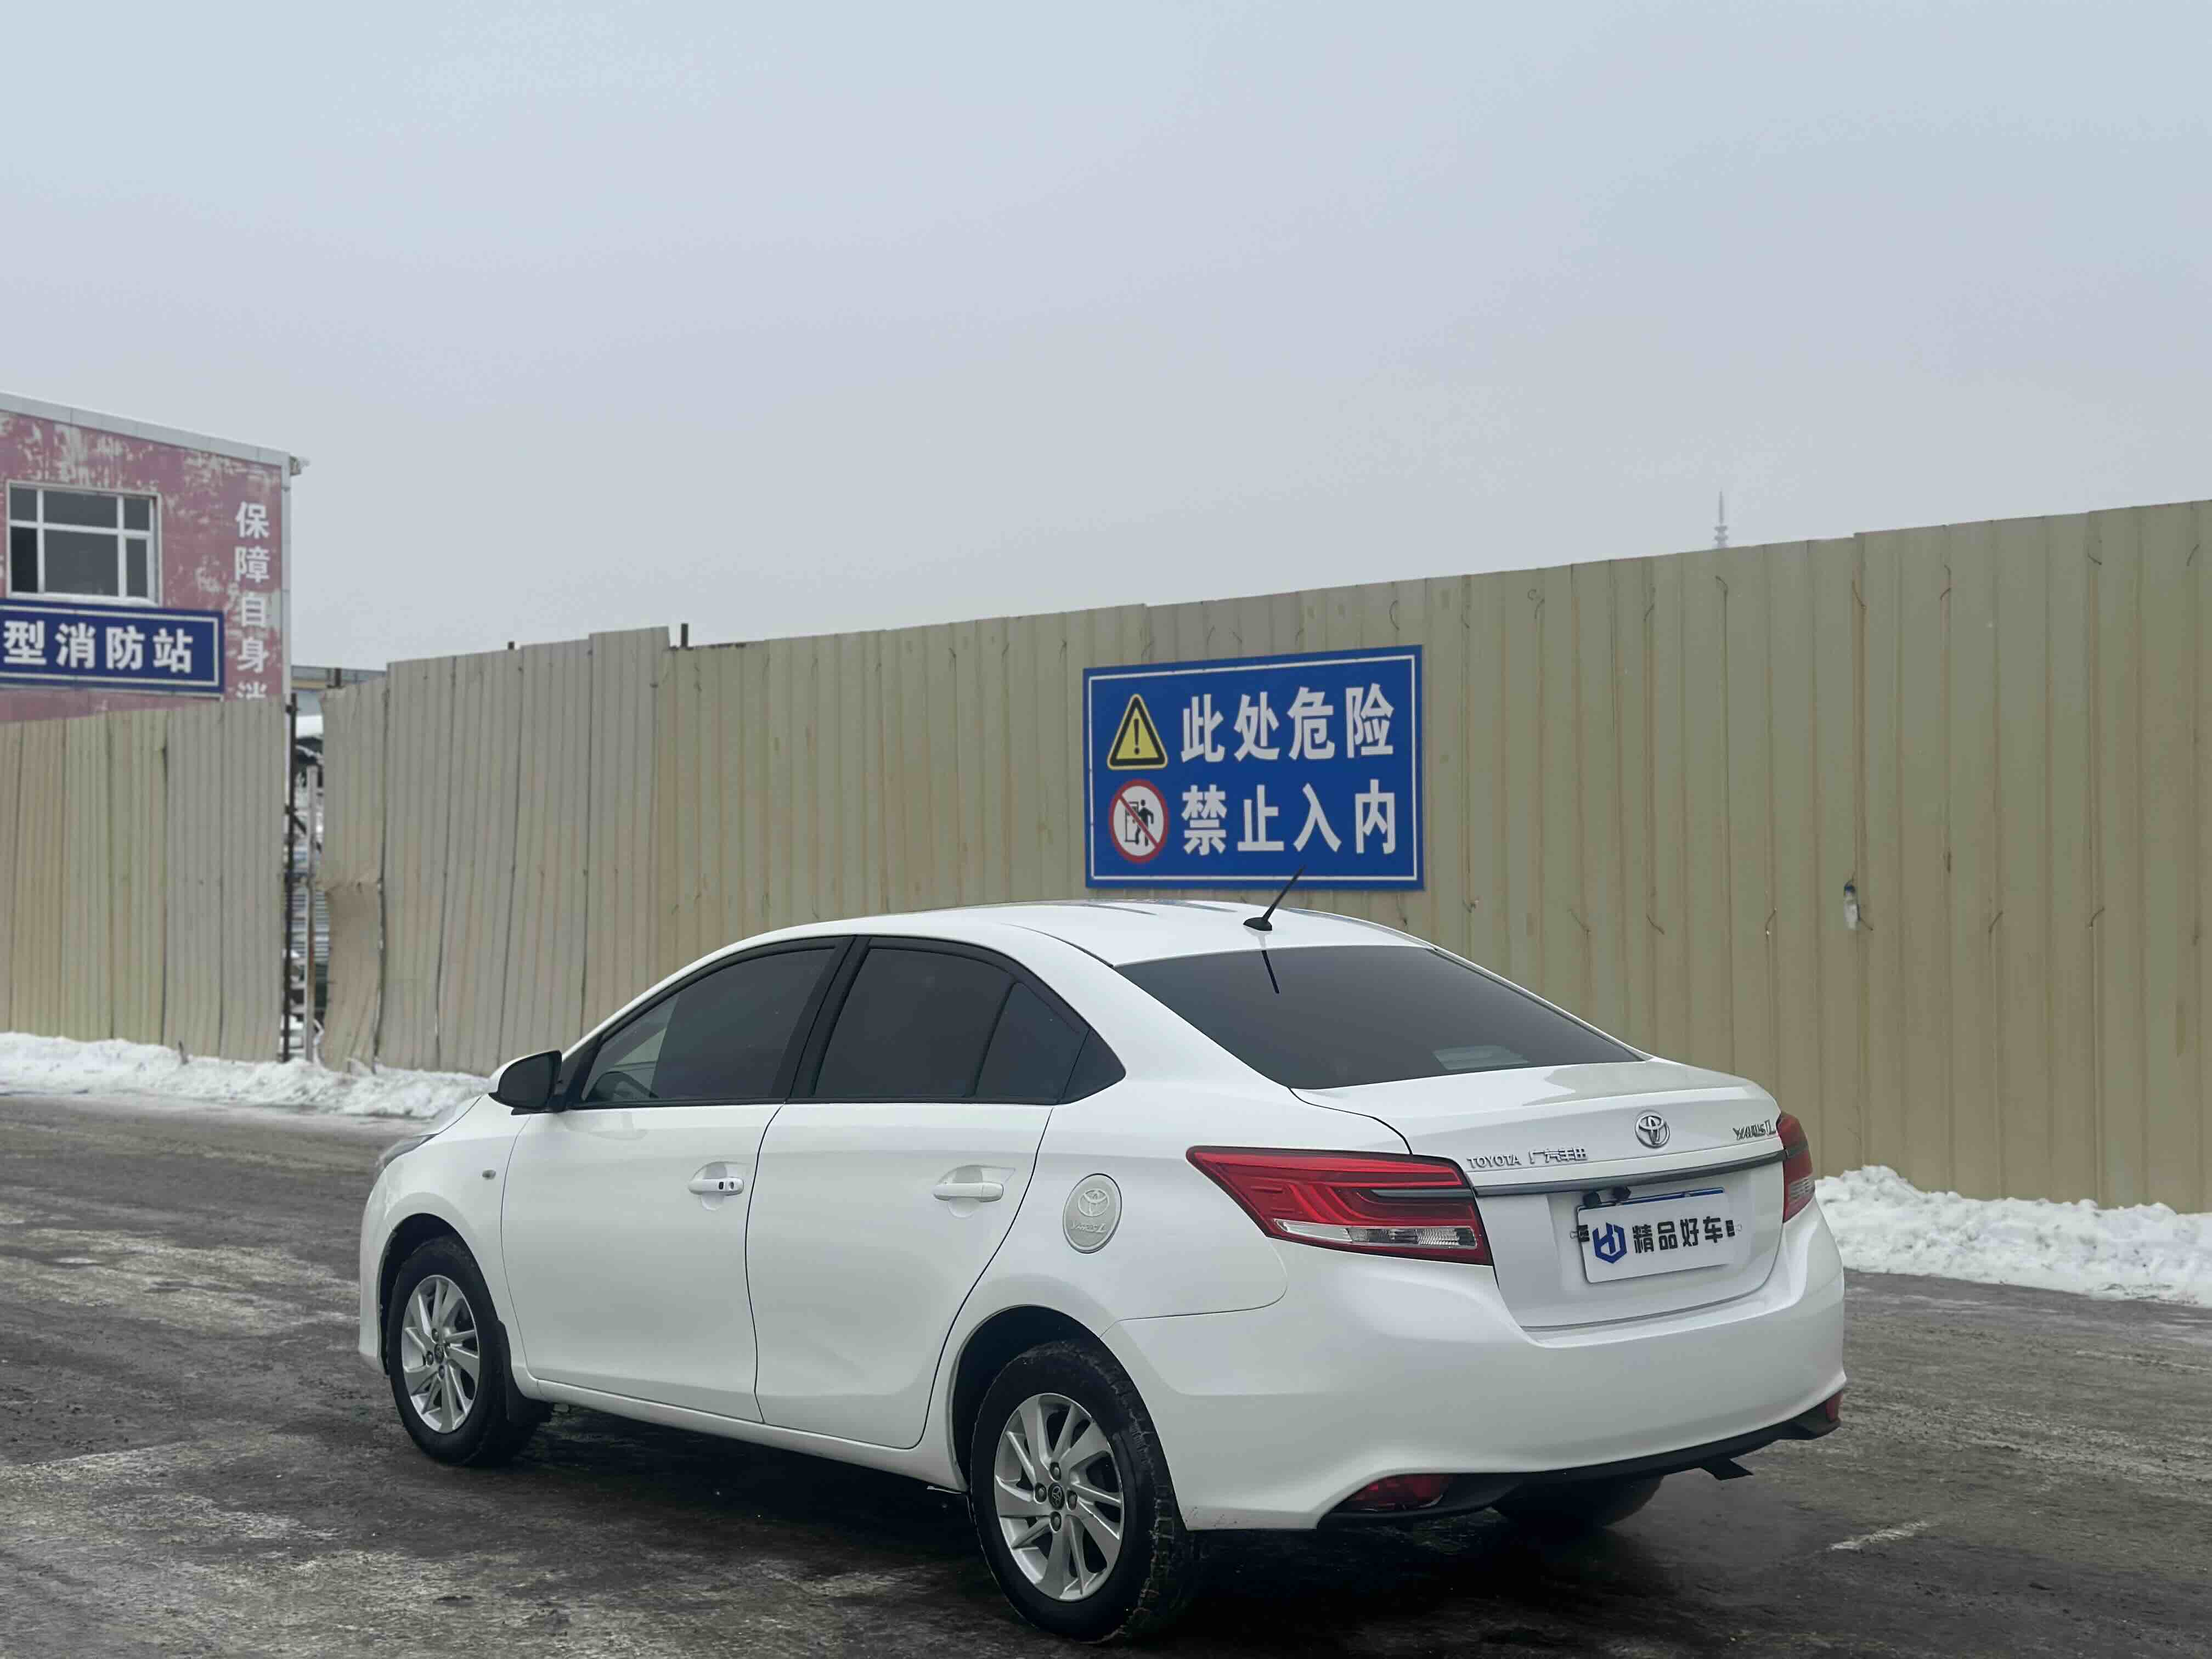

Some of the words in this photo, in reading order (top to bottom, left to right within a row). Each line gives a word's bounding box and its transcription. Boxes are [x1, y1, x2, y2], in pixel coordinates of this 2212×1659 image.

[3, 620, 194, 674] 型消防站
[1180, 682, 1395, 764] 此处危险
[1181, 778, 1396, 856] 禁止入内
[1466, 1154, 1522, 1169] TOYOTA
[1632, 1216, 1724, 1254] 精品好车
